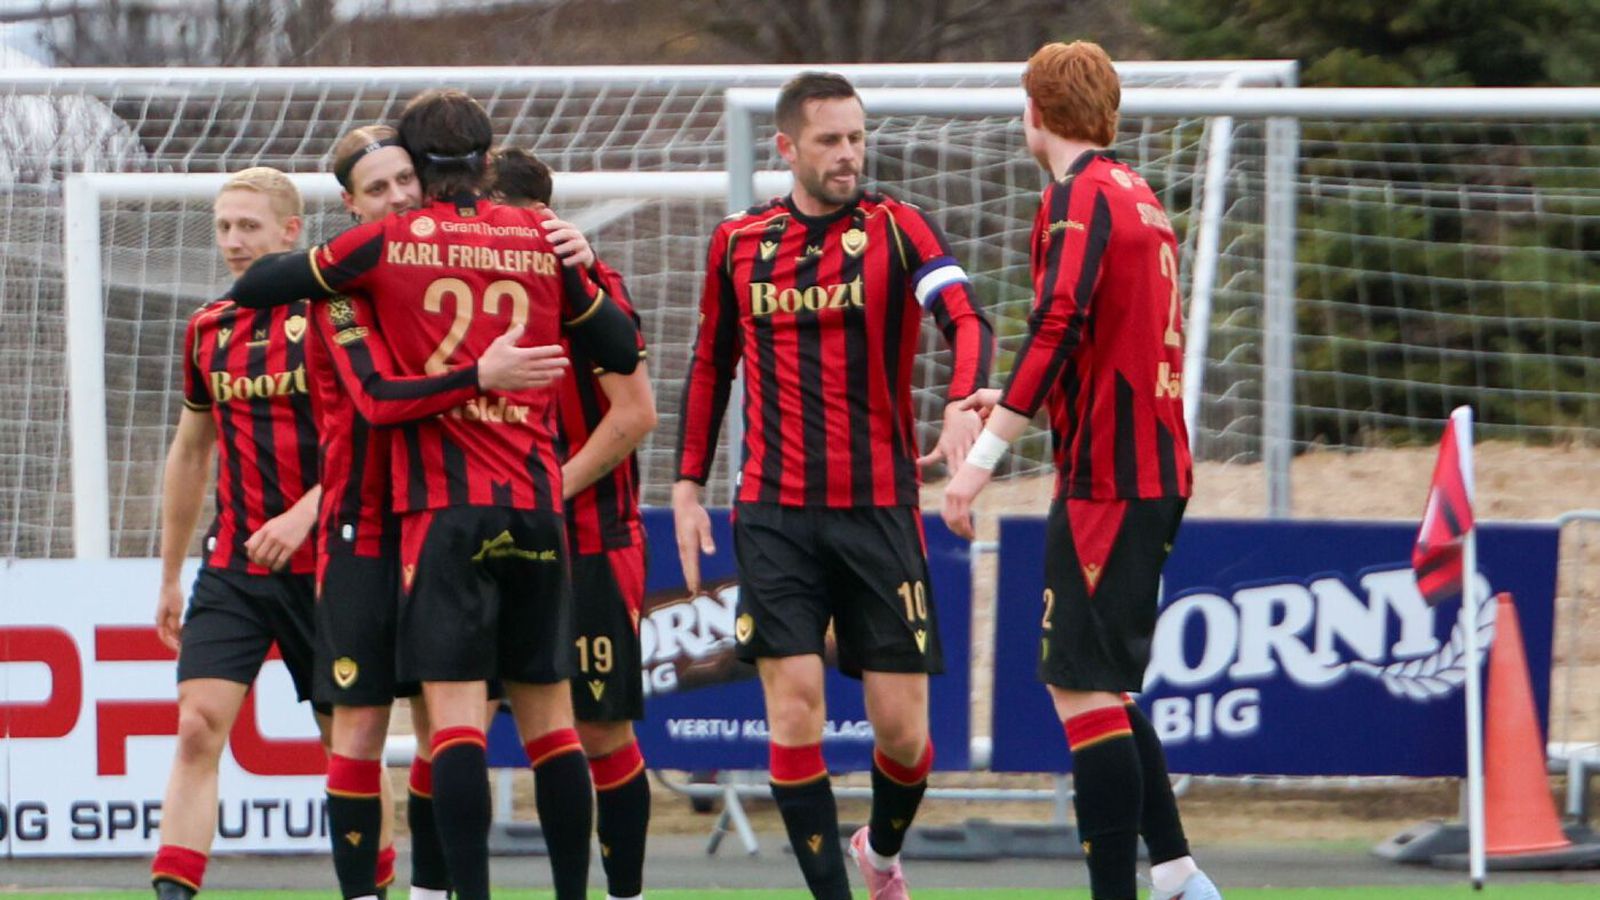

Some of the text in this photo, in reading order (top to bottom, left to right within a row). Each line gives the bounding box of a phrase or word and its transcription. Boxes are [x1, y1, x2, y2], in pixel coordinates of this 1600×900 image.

[387, 241, 443, 266] KARL
[749, 273, 865, 316] Boozt
[424, 277, 529, 376] 22
[210, 362, 308, 402] Boozt
[897, 581, 927, 622] 10
[1141, 567, 1440, 692] ORNY
[576, 635, 612, 673] 19
[667, 719, 738, 737] VERTU
[742, 719, 770, 736] KL
[1152, 688, 1261, 742] BIG
[0, 801, 48, 841] G
